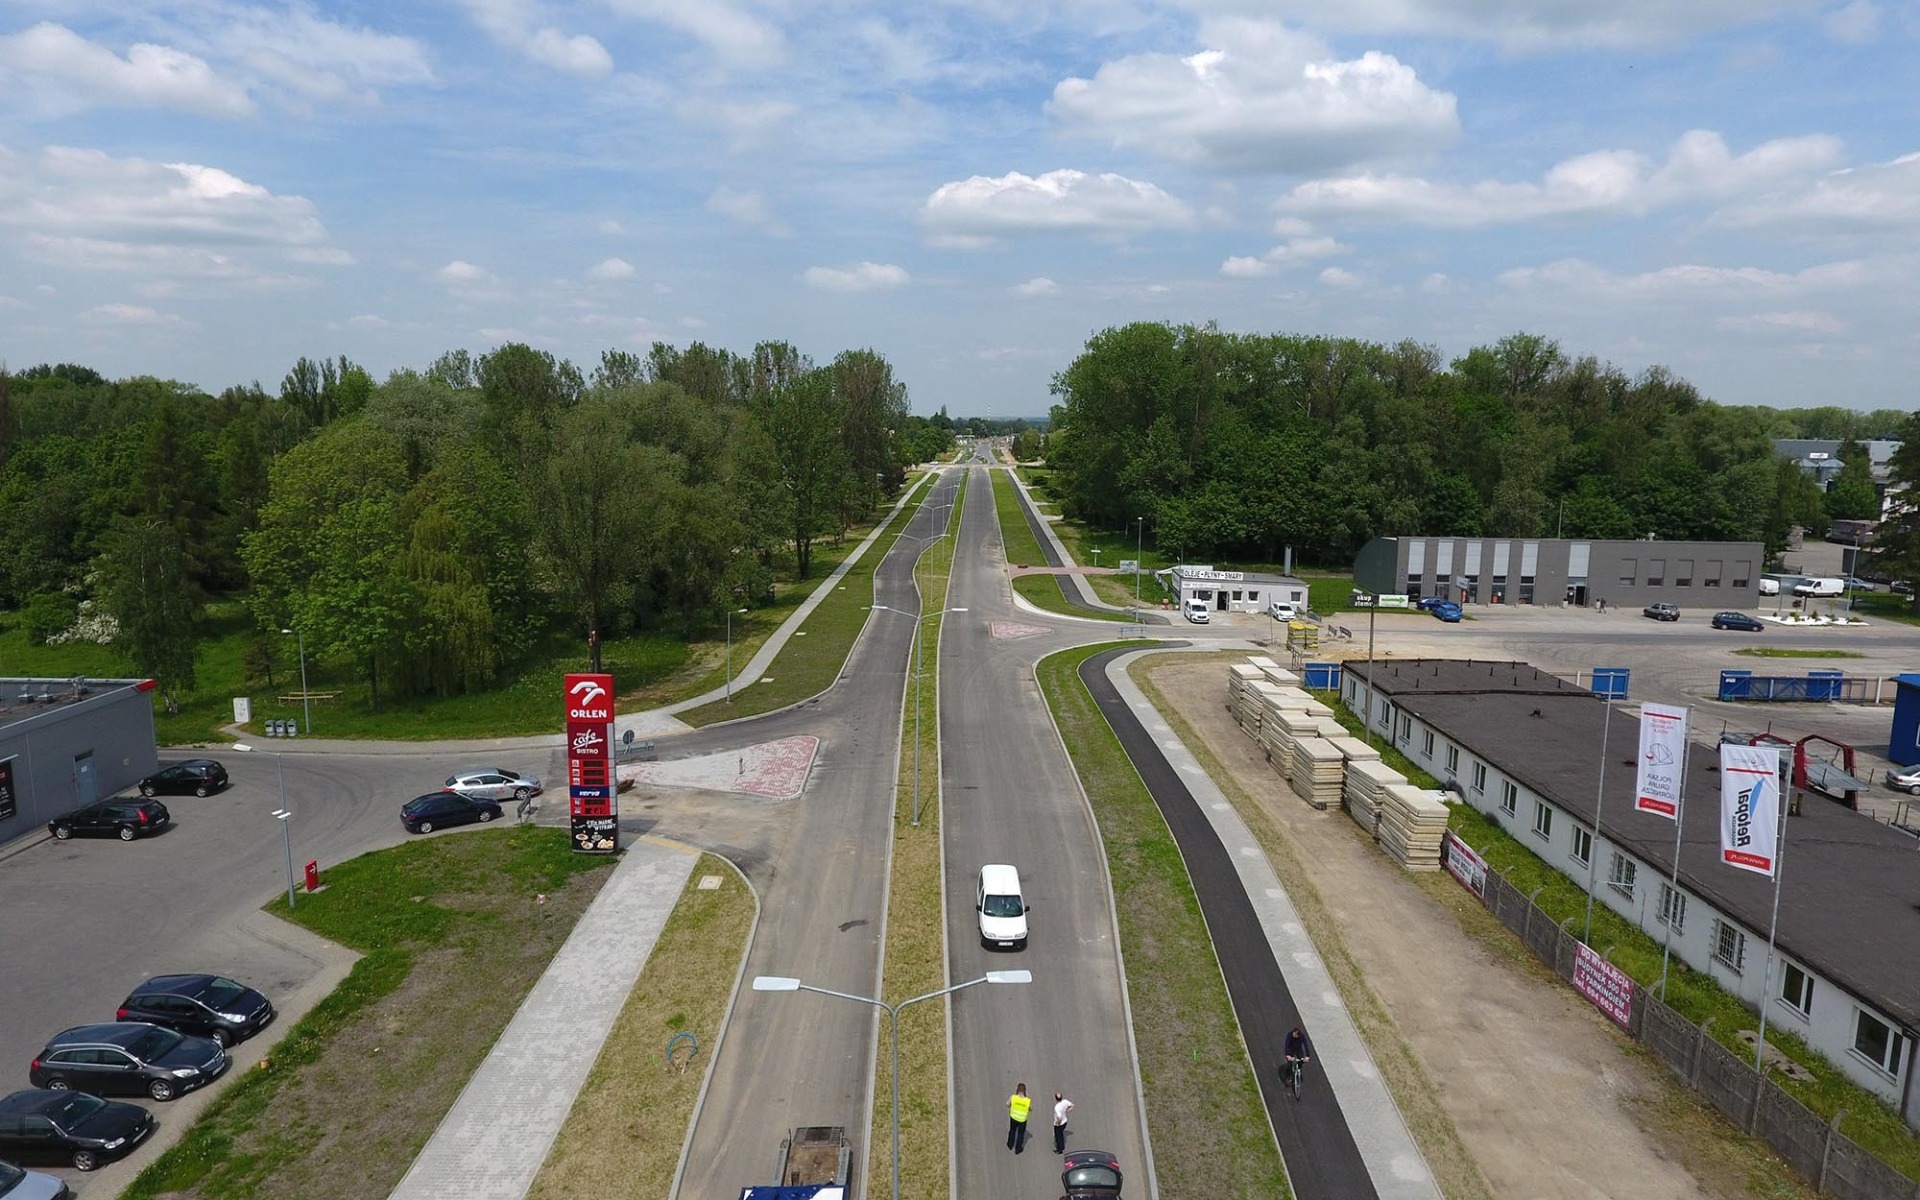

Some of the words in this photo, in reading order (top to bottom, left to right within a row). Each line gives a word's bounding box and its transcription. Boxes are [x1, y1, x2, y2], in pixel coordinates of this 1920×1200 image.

[570, 709, 607, 718] ORLEN
[1581, 948, 1591, 959] DO
[1578, 958, 1606, 984] BUDYNEK
[1608, 980, 1619, 994] 500
[1580, 970, 1585, 979] Z
[1586, 975, 1625, 1010] PARKINGIEM
